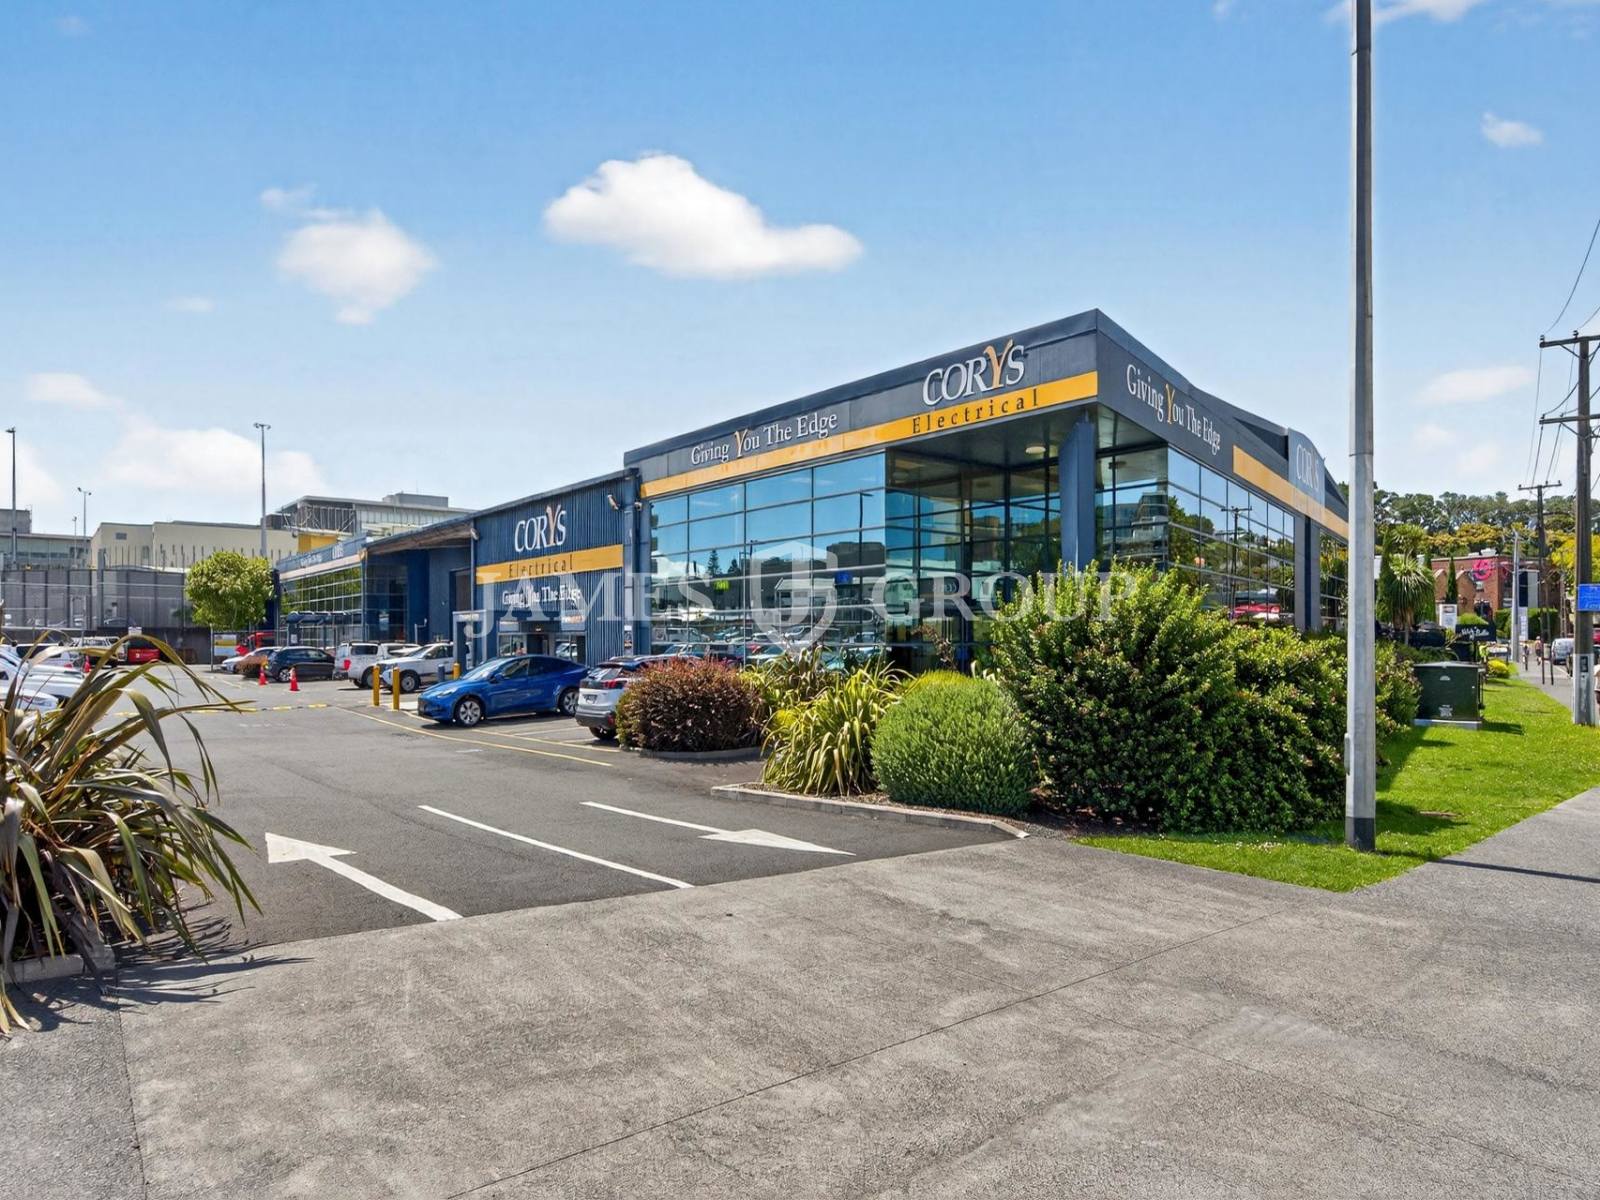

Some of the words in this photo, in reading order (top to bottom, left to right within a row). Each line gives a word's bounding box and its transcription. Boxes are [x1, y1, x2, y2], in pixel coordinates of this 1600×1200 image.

[922, 338, 1025, 406] CORYS
[912, 388, 1039, 434] Electrical
[1126, 364, 1164, 423] Giving
[1165, 383, 1184, 426] You
[1186, 404, 1202, 437] The
[1202, 416, 1221, 456] Edge
[691, 442, 730, 463] Giving
[734, 428, 760, 458] You
[763, 423, 792, 446] The
[797, 411, 838, 438] Edge
[514, 504, 567, 552] CORYS
[508, 554, 573, 578] Electrical
